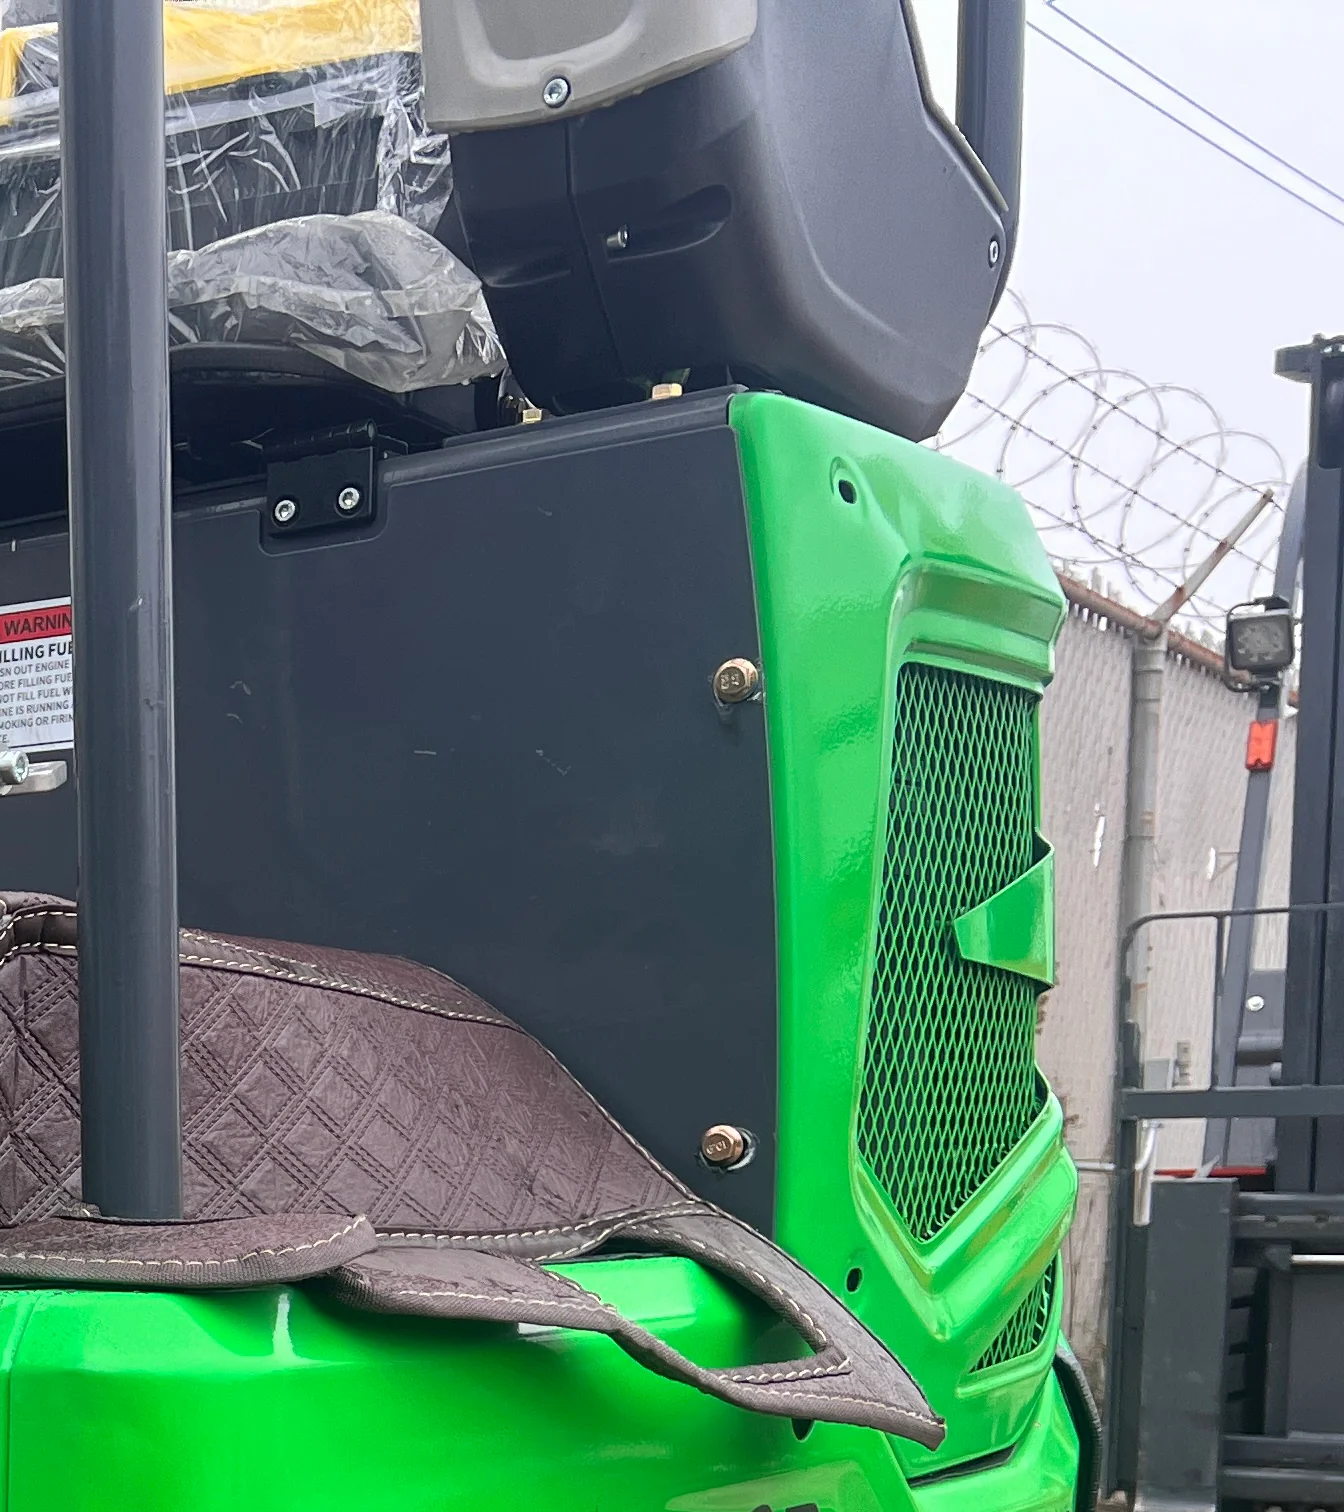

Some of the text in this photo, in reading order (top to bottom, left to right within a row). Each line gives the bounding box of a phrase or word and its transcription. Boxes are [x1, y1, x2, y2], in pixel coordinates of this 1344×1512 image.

[4, 613, 72, 636] WARNIN
[48, 641, 73, 657] FUE
[14, 664, 33, 675] OUT
[35, 659, 70, 672] ENGINE
[18, 675, 52, 688] FILLING
[55, 672, 73, 683] FUE
[17, 691, 35, 701] FILL
[38, 688, 60, 699] FUEL
[16, 706, 24, 715] IS
[26, 700, 69, 714] RUNNING
[36, 716, 48, 726] OR
[51, 714, 73, 724] FIRIN
